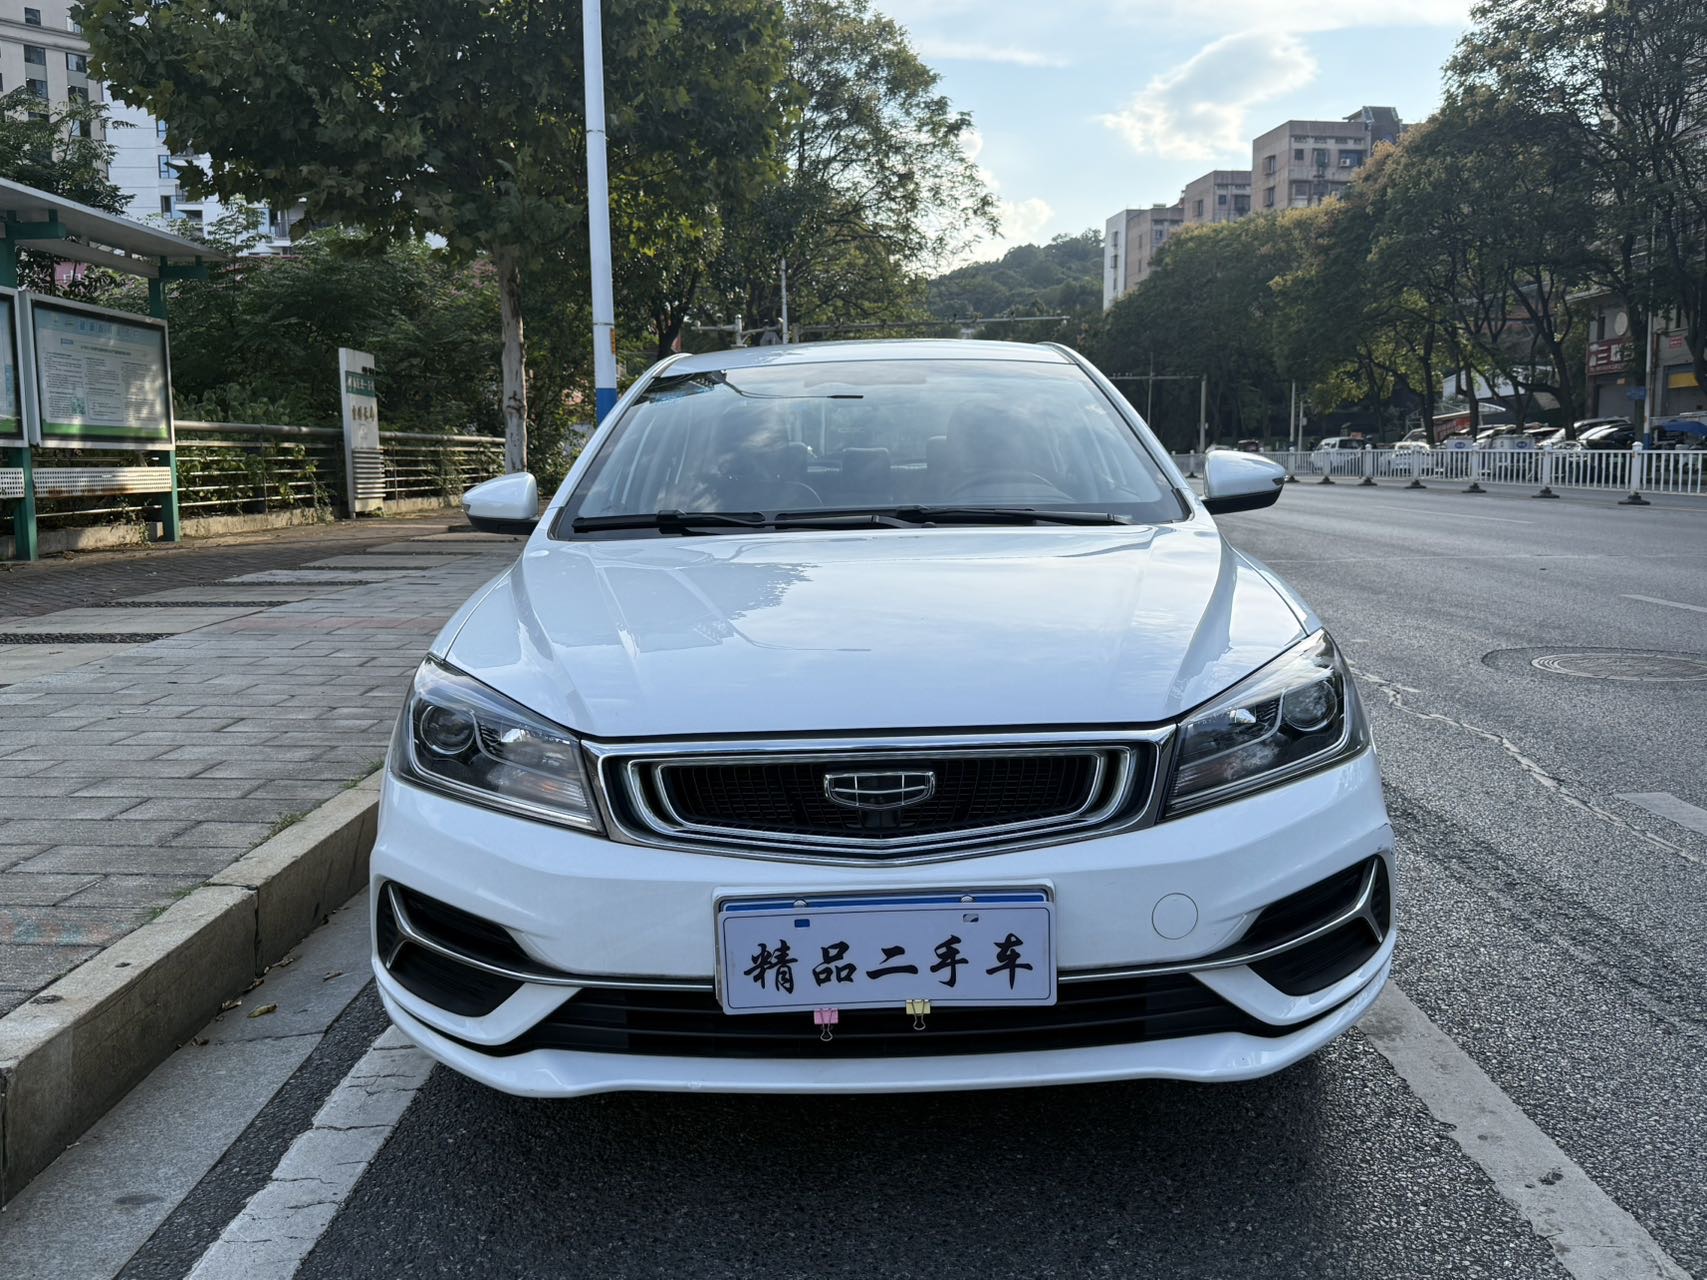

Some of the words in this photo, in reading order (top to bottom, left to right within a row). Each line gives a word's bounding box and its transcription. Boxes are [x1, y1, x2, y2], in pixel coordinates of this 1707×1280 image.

[743, 932, 1034, 995] 精品二手车
